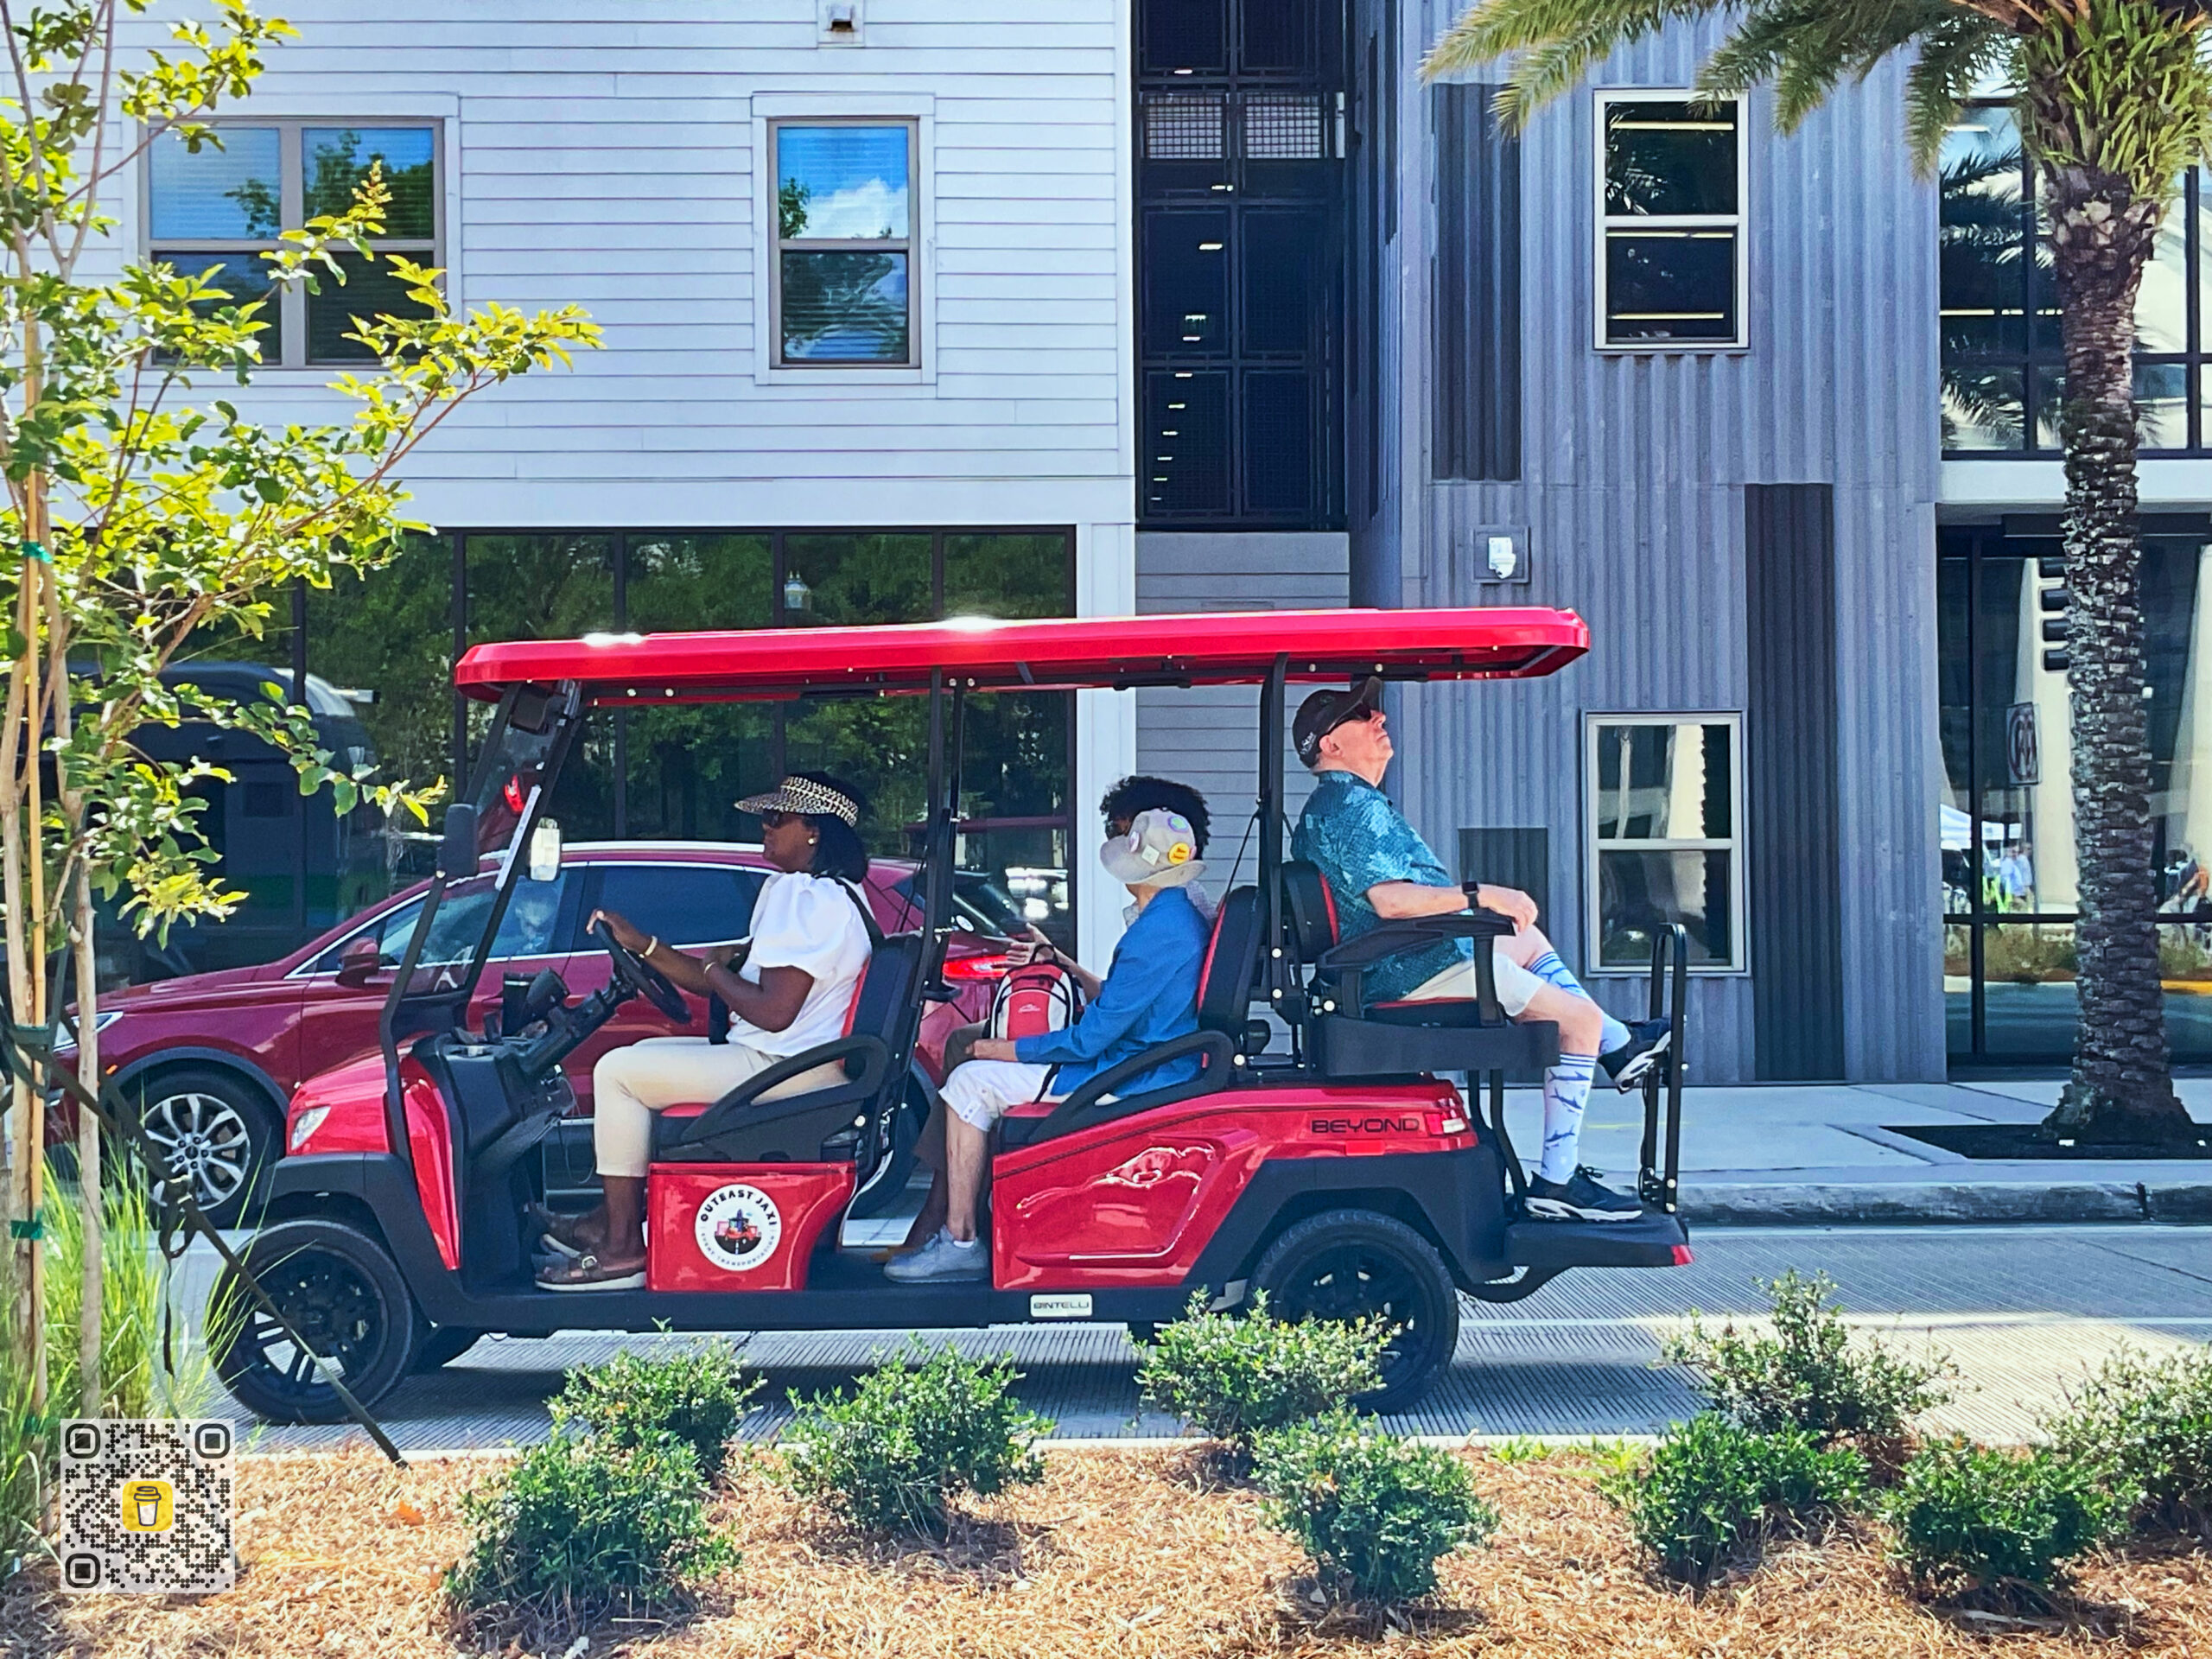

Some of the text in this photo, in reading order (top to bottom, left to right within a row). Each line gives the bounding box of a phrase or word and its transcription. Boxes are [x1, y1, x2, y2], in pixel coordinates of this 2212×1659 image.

[1312, 1118, 1420, 1134] BEYOND
[700, 1189, 778, 1225] OUTEAST JAXI
